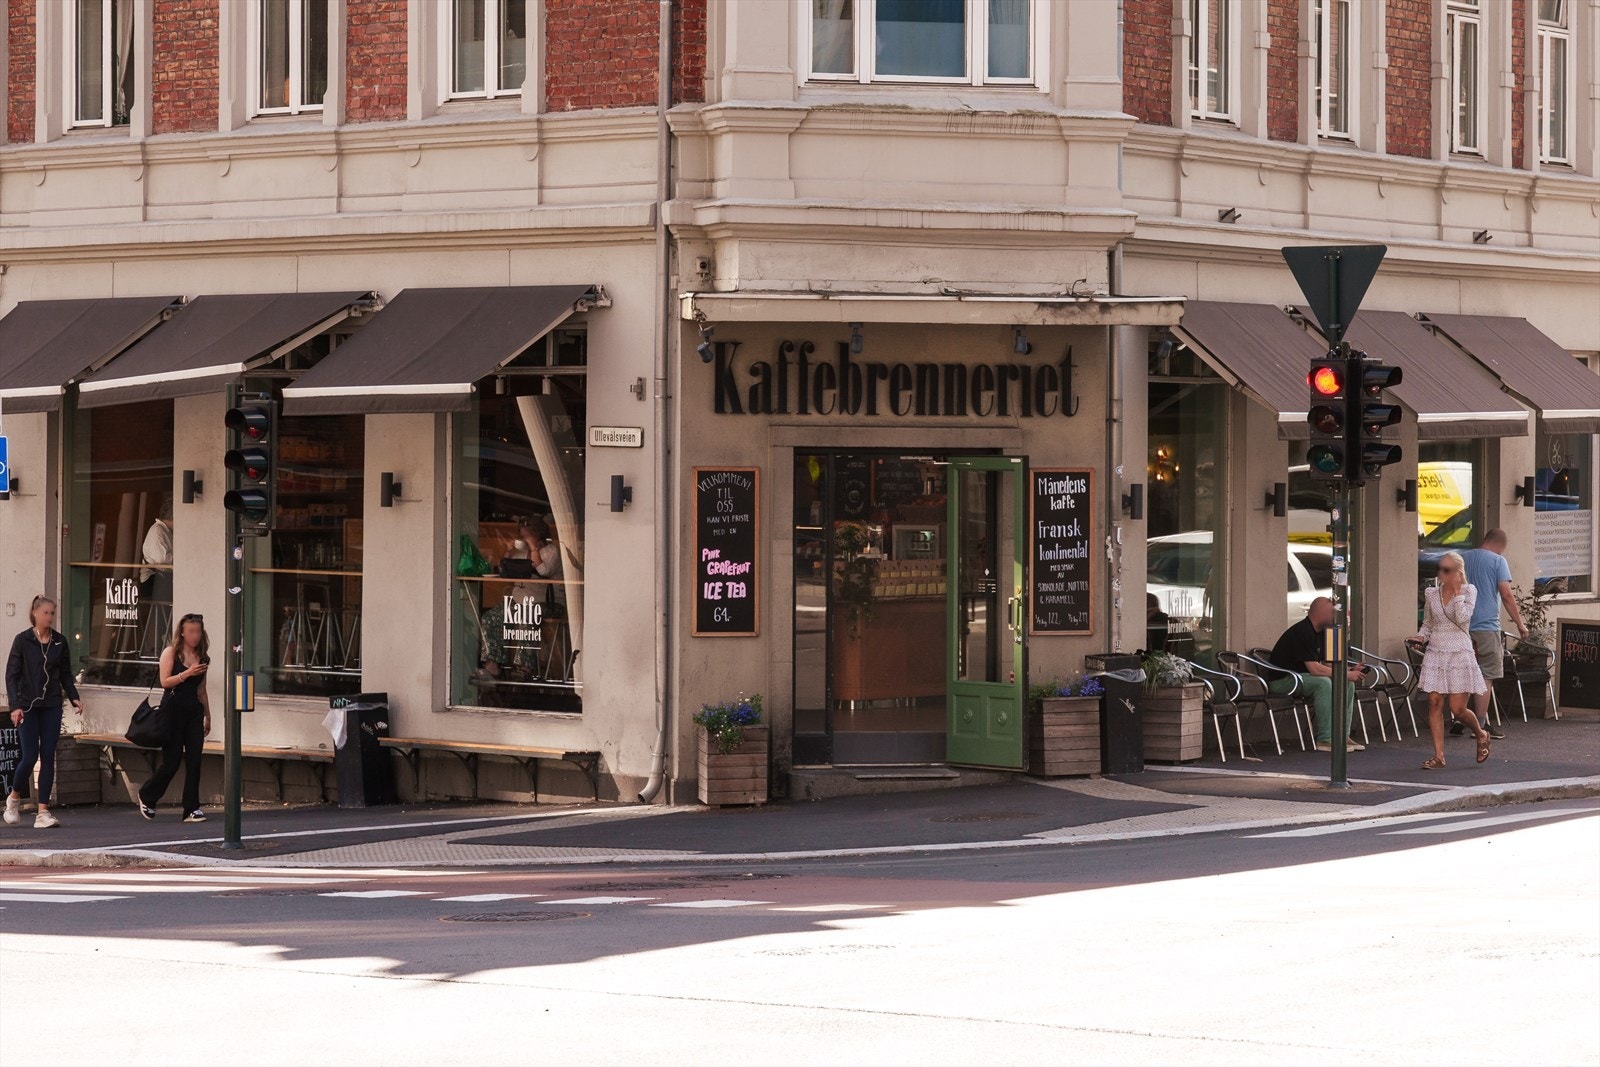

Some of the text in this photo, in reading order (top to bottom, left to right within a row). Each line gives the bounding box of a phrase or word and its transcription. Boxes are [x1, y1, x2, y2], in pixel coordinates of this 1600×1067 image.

[713, 340, 1079, 417] Kaffebrenneriet
[594, 430, 636, 443] Ullevålsveien
[697, 472, 752, 492] VELKOMMEN!
[1038, 475, 1087, 495] Månedens
[717, 487, 734, 499] TIL
[1050, 494, 1075, 510] kaffe
[716, 500, 734, 513] OSS
[722, 515, 730, 523] VI
[1038, 517, 1082, 538] Fransk
[1039, 540, 1088, 560] kontinental
[105, 578, 138, 605] Kaffe
[704, 581, 746, 600] ICE TEA
[1045, 594, 1076, 604] KARAMELL
[105, 605, 138, 620] brenneriet
[503, 595, 542, 625] Kaffe
[1168, 590, 1193, 617] Kaffe
[503, 625, 541, 641] brenneriet
[0, 728, 18, 745] AFFE
